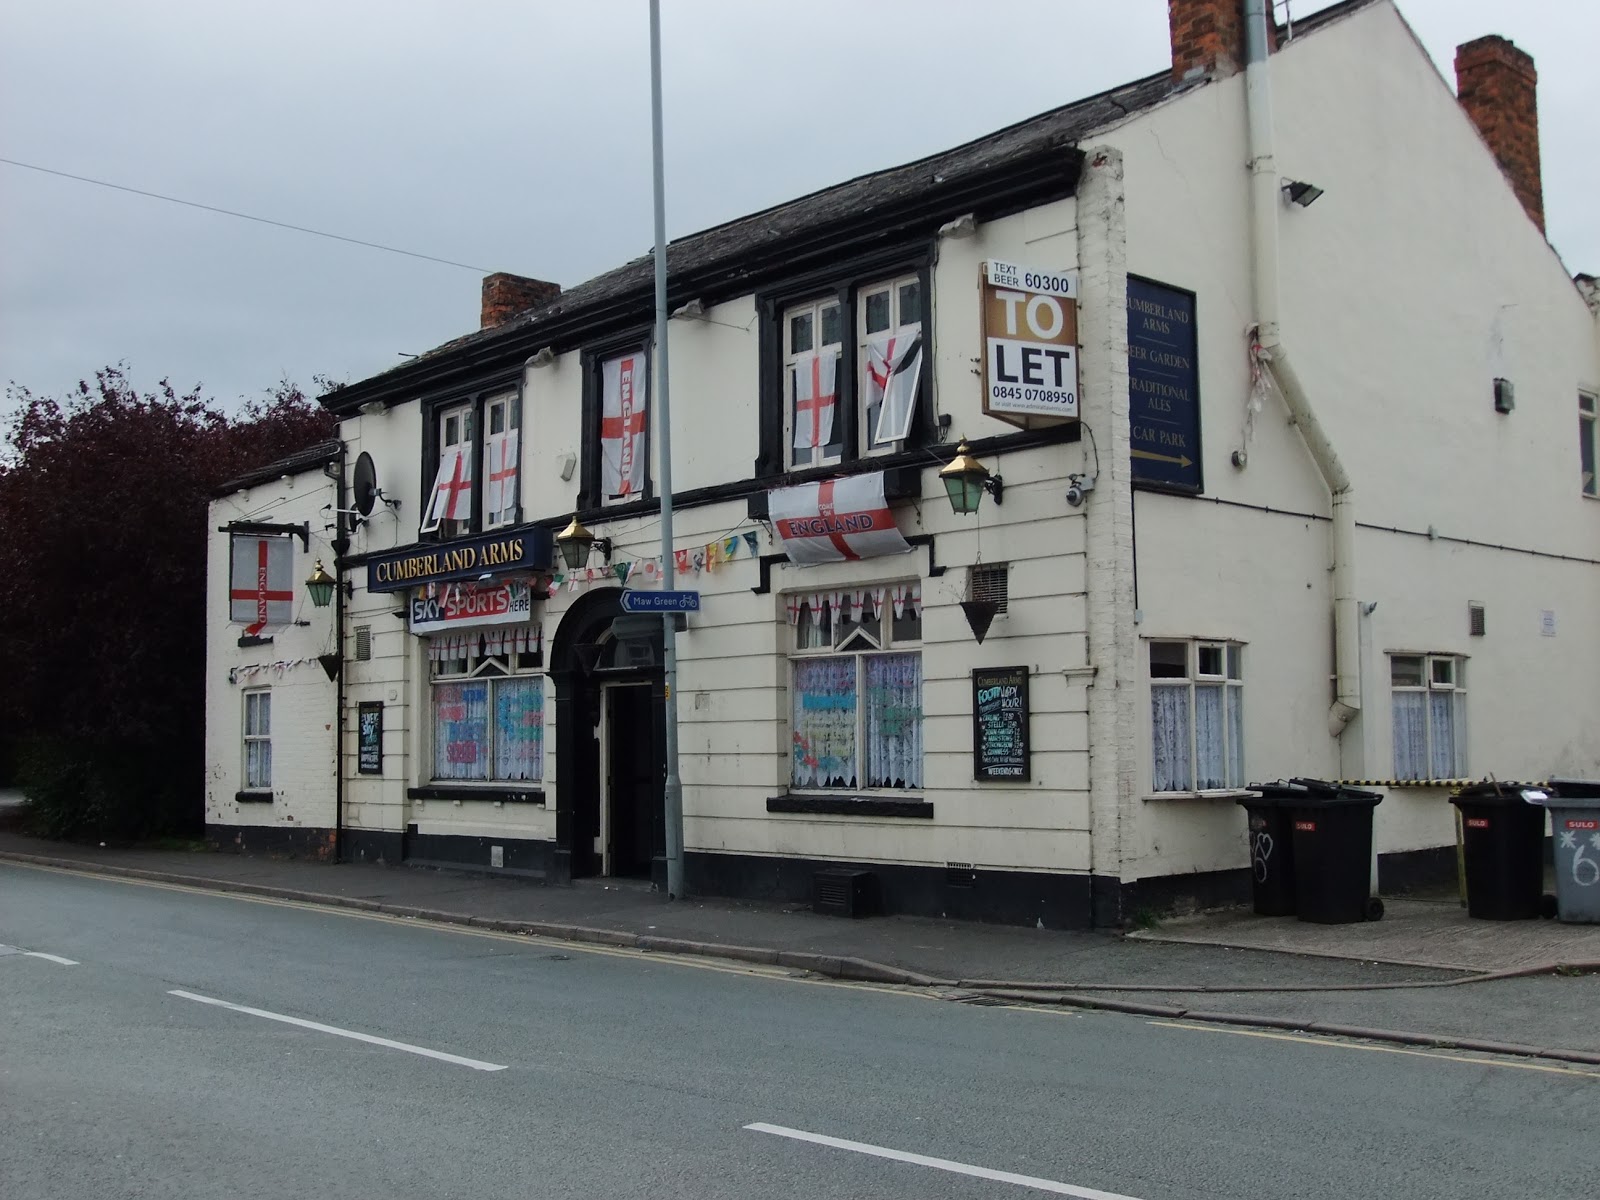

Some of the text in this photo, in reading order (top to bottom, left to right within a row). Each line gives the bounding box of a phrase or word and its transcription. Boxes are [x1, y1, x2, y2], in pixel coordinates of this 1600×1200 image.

[994, 262, 1017, 275] TEXT
[994, 273, 1019, 287] BEER
[1025, 272, 1069, 293] 60300
[995, 289, 1064, 339] TO
[1127, 296, 1189, 324] UMBERLAND
[1143, 317, 1170, 334] ARMS
[996, 344, 1070, 387] LET
[1128, 345, 1190, 368] EER GARDEN
[993, 386, 1075, 404] 0845 0708950
[1147, 397, 1172, 412] ALES
[621, 370, 632, 480] ENGLAND
[1133, 425, 1186, 447] CAR PARK
[789, 512, 874, 537] ENGLAND
[376, 538, 524, 583] CUMBERLAND ARMS
[447, 588, 508, 617] SPORTS
[509, 599, 530, 612] HERE
[633, 596, 677, 606] Maw Green
[1468, 819, 1485, 827] SULO
[1568, 820, 1595, 829] SULO
[1571, 843, 1600, 887] 6
